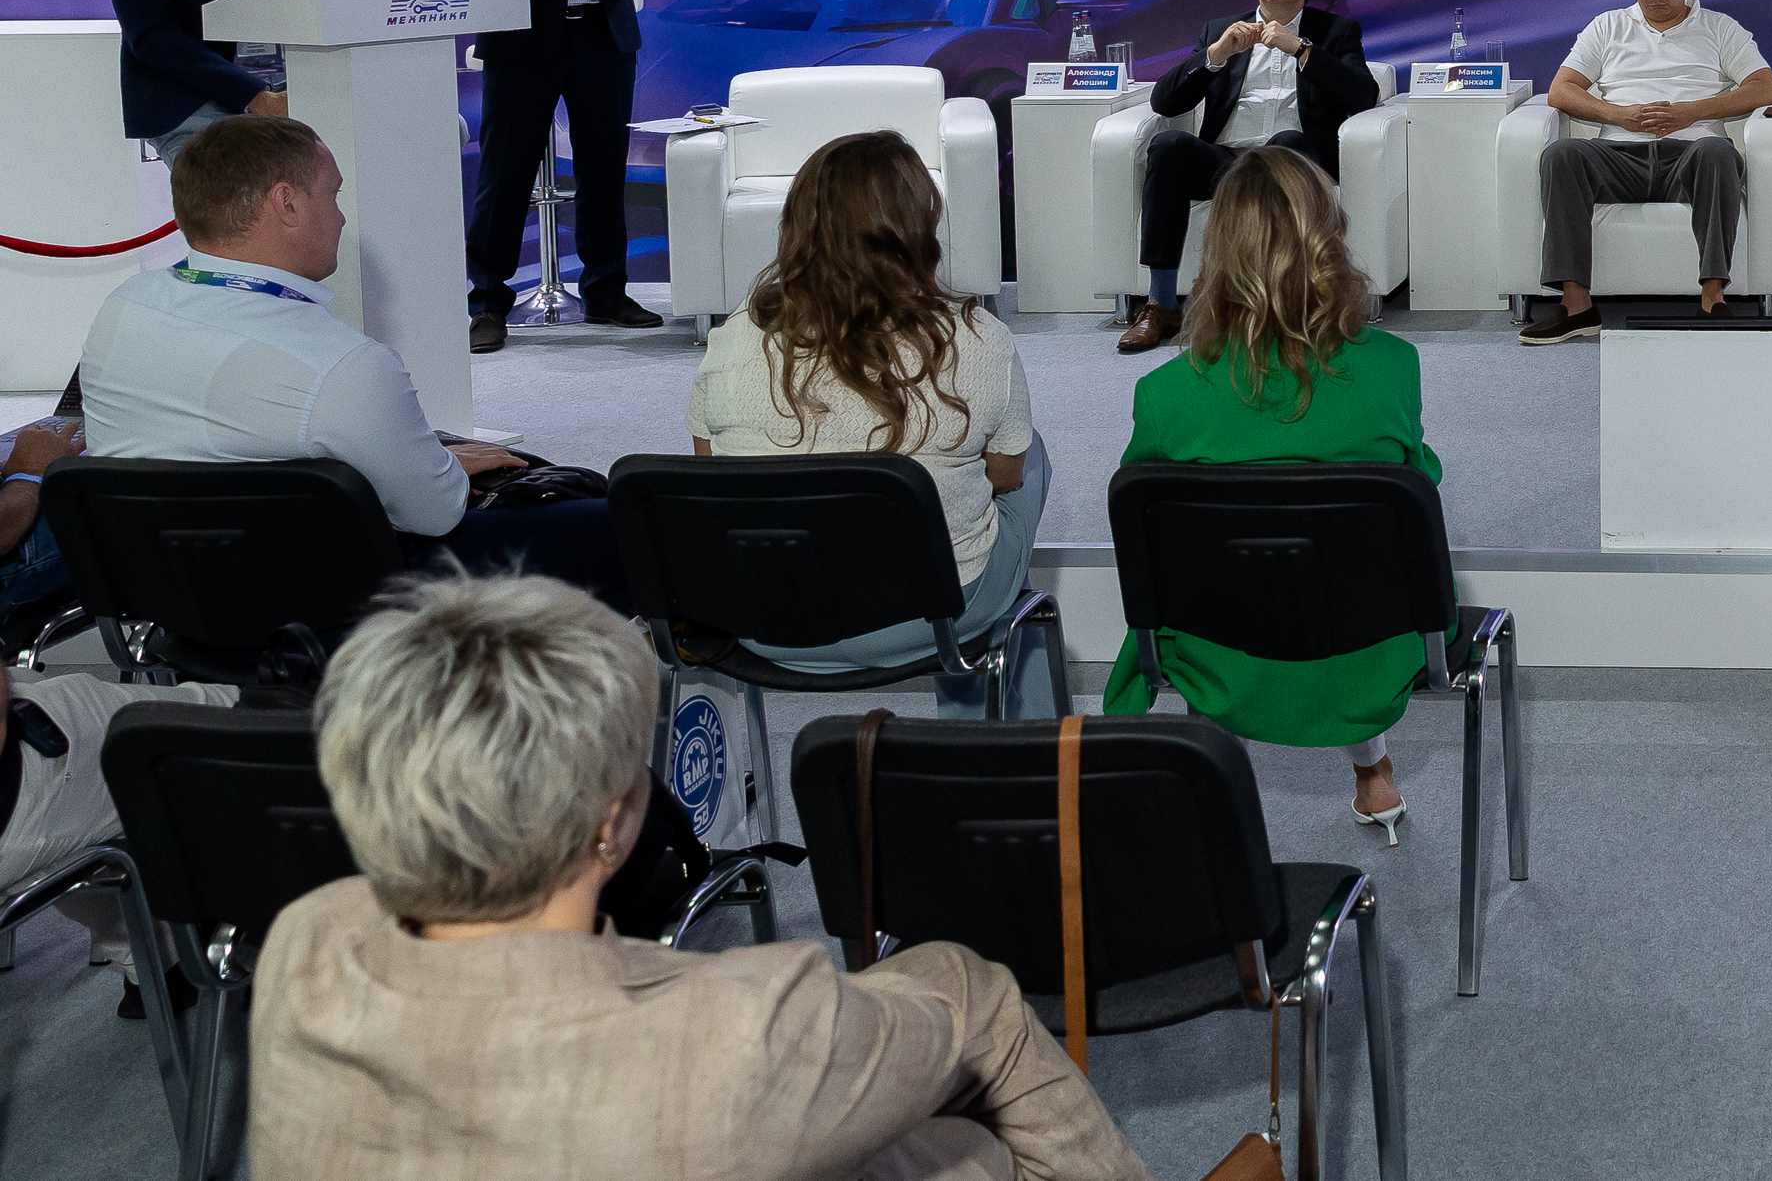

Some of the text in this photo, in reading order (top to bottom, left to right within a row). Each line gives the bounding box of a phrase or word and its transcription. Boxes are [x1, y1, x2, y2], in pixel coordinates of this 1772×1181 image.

[386, 9, 468, 26] МЕХАНИКА
[1067, 69, 1116, 78] Александр
[1458, 68, 1493, 77] Максим
[1072, 78, 1109, 87] Алешин
[683, 755, 710, 789] RMP
